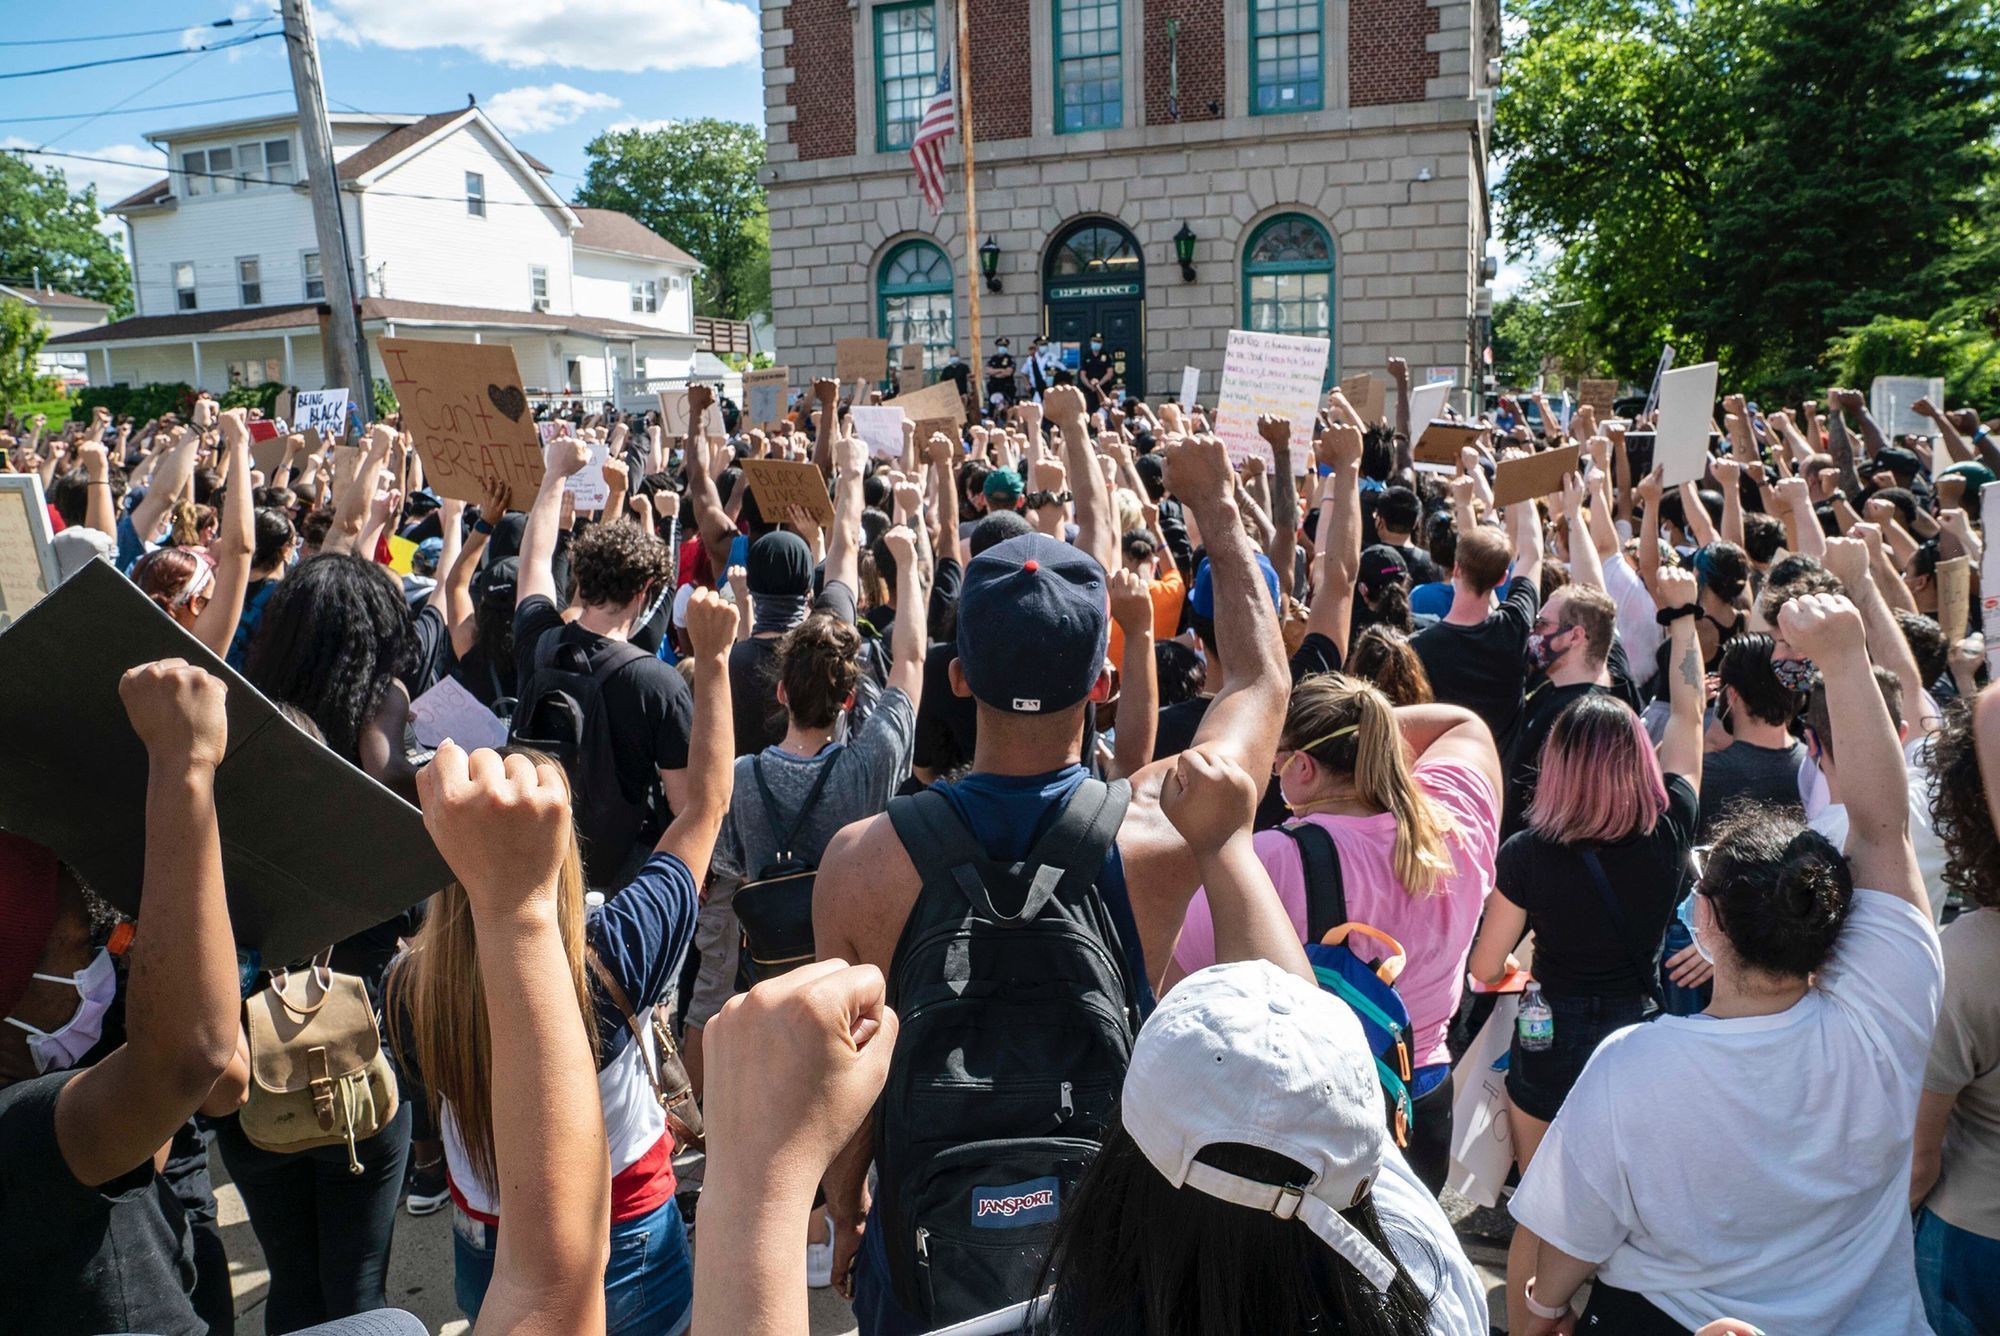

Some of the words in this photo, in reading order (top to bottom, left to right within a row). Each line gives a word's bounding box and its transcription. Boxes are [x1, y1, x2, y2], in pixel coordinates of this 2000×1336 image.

[1059, 288, 1079, 298] 123
[1081, 285, 1129, 296] PRECINCT
[386, 349, 417, 384] I
[298, 393, 324, 408] BEING
[310, 401, 343, 422] BLACK
[415, 387, 494, 440] Can't
[426, 436, 542, 487] BREATHE
[752, 467, 804, 487] BLACK
[764, 489, 811, 503] LIVES
[977, 1190, 1053, 1217] JANSPORT
